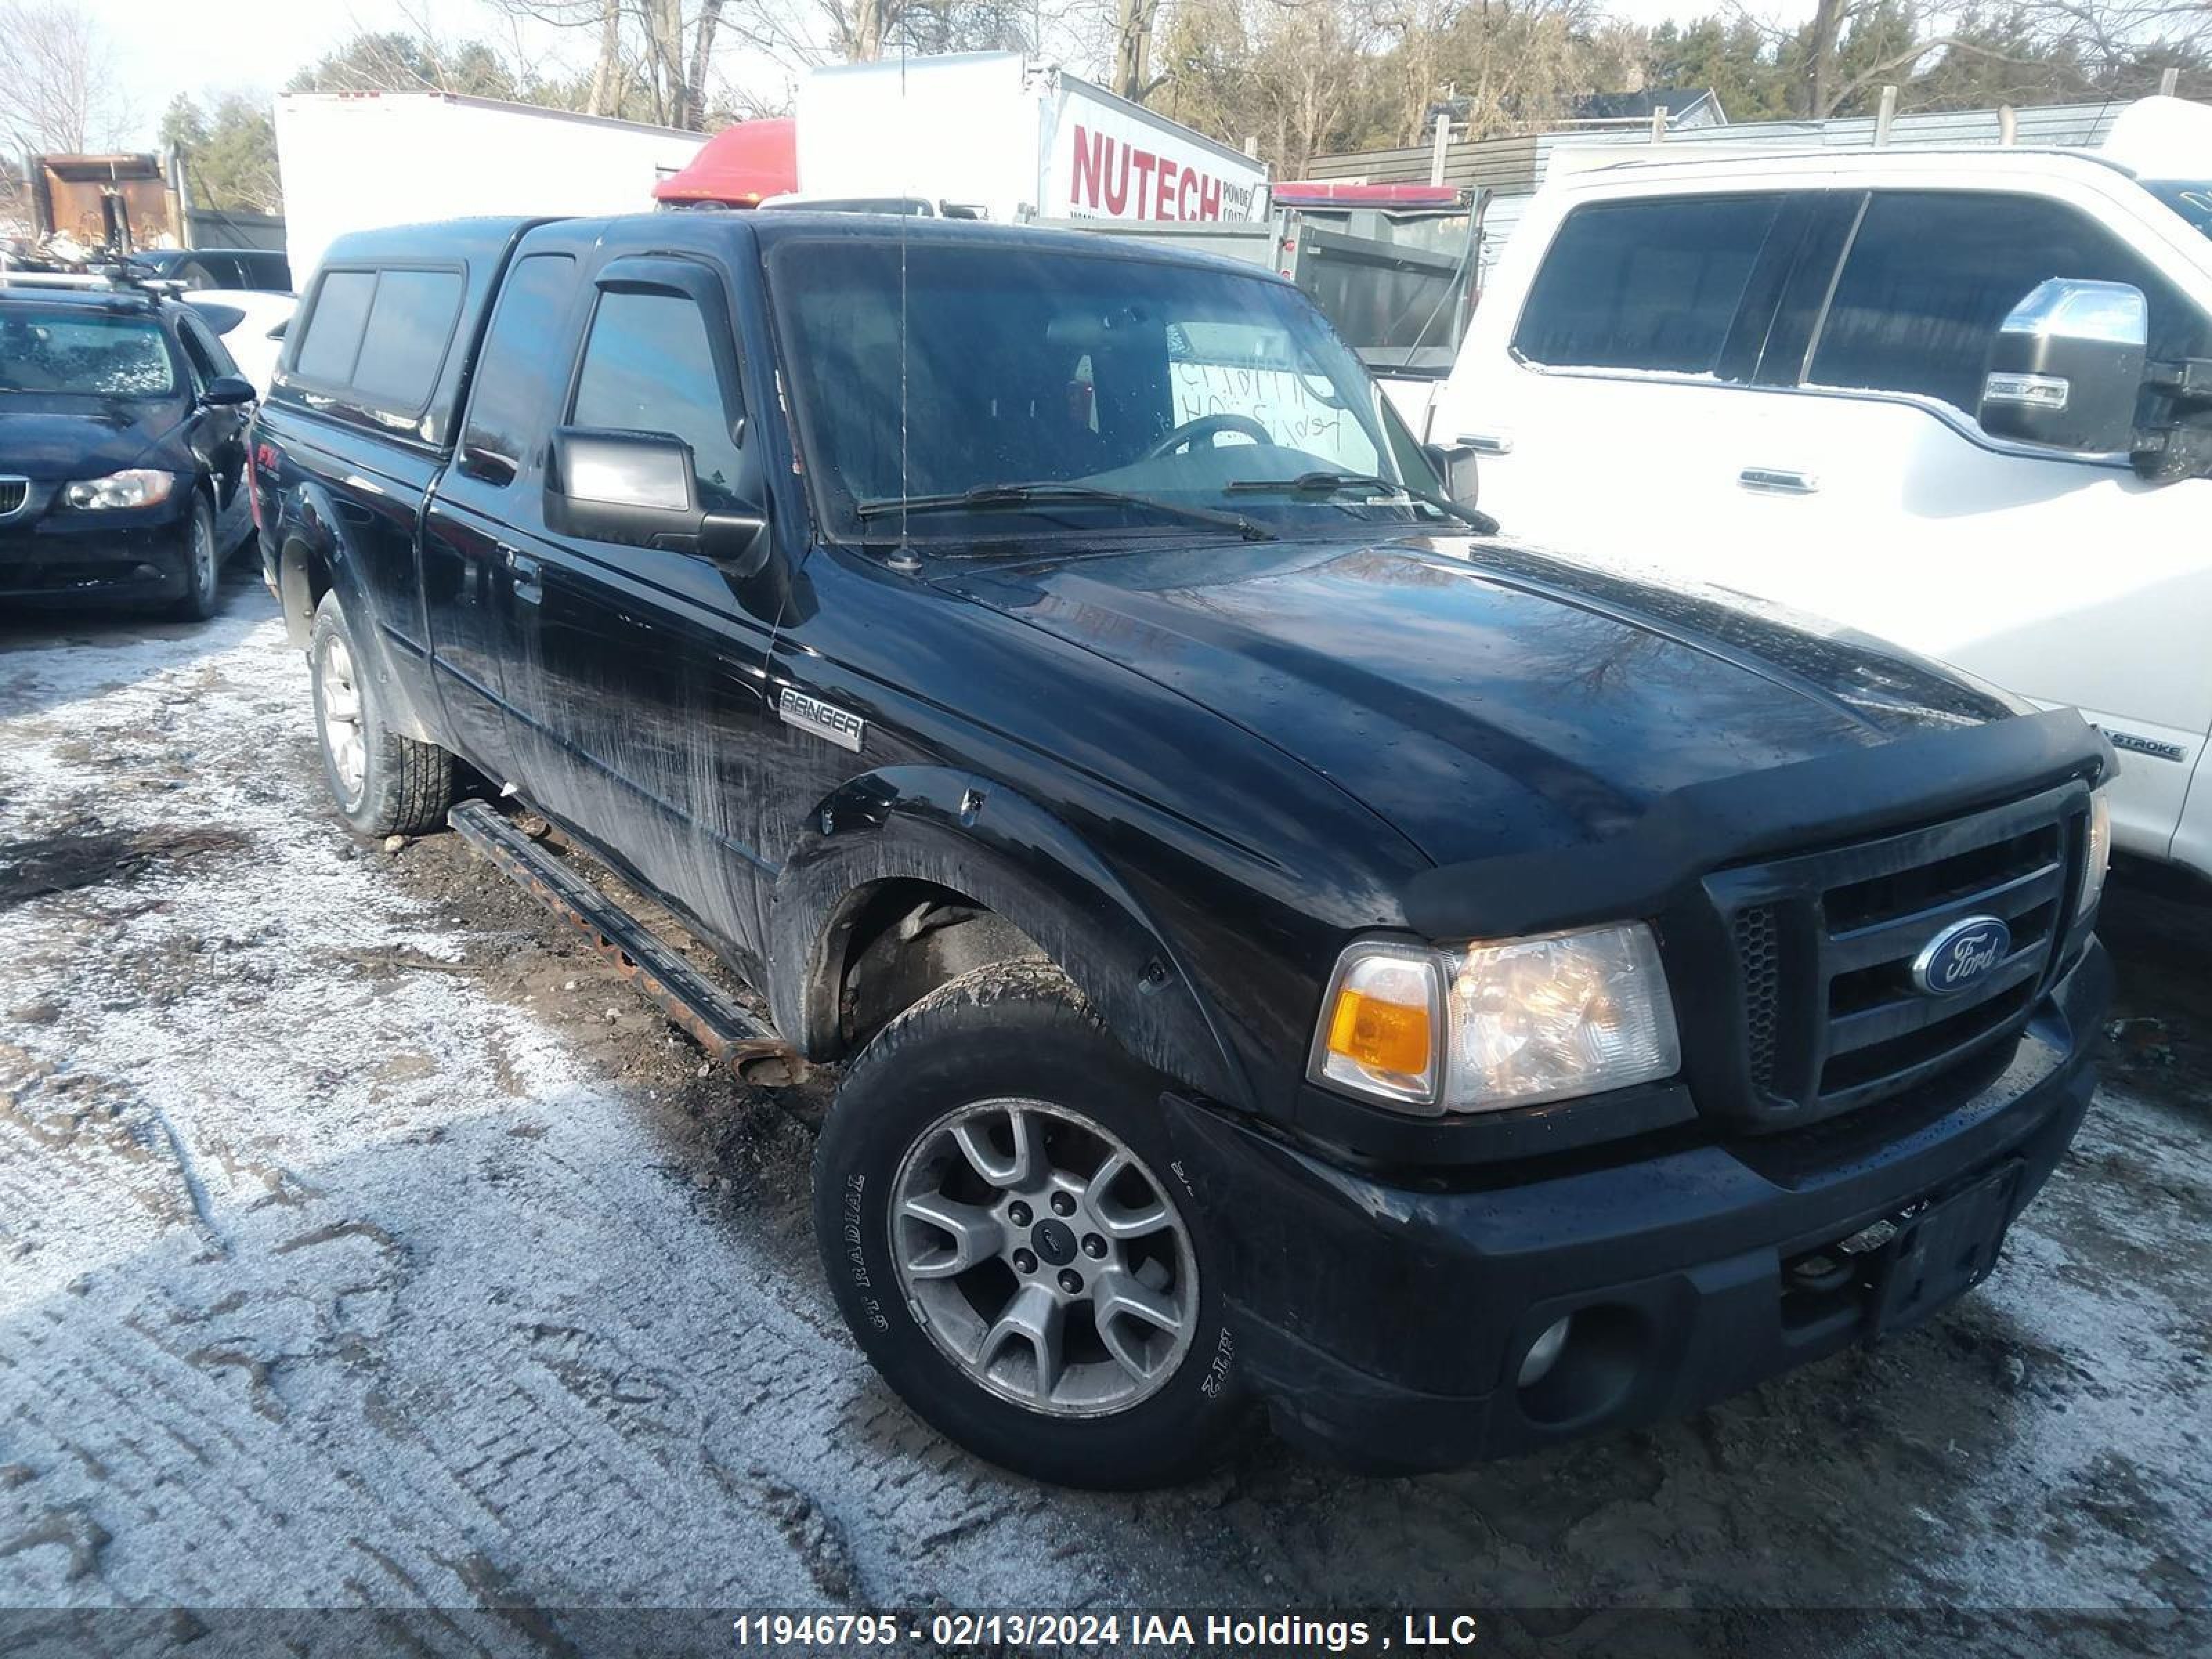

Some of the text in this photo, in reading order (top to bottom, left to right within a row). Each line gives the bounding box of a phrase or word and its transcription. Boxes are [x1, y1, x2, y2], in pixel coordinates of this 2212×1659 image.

[1070, 124, 1221, 221] NUTECH
[782, 692, 859, 738] RANGER
[2111, 733, 2182, 758] STROKE
[1946, 932, 1998, 982] Ford
